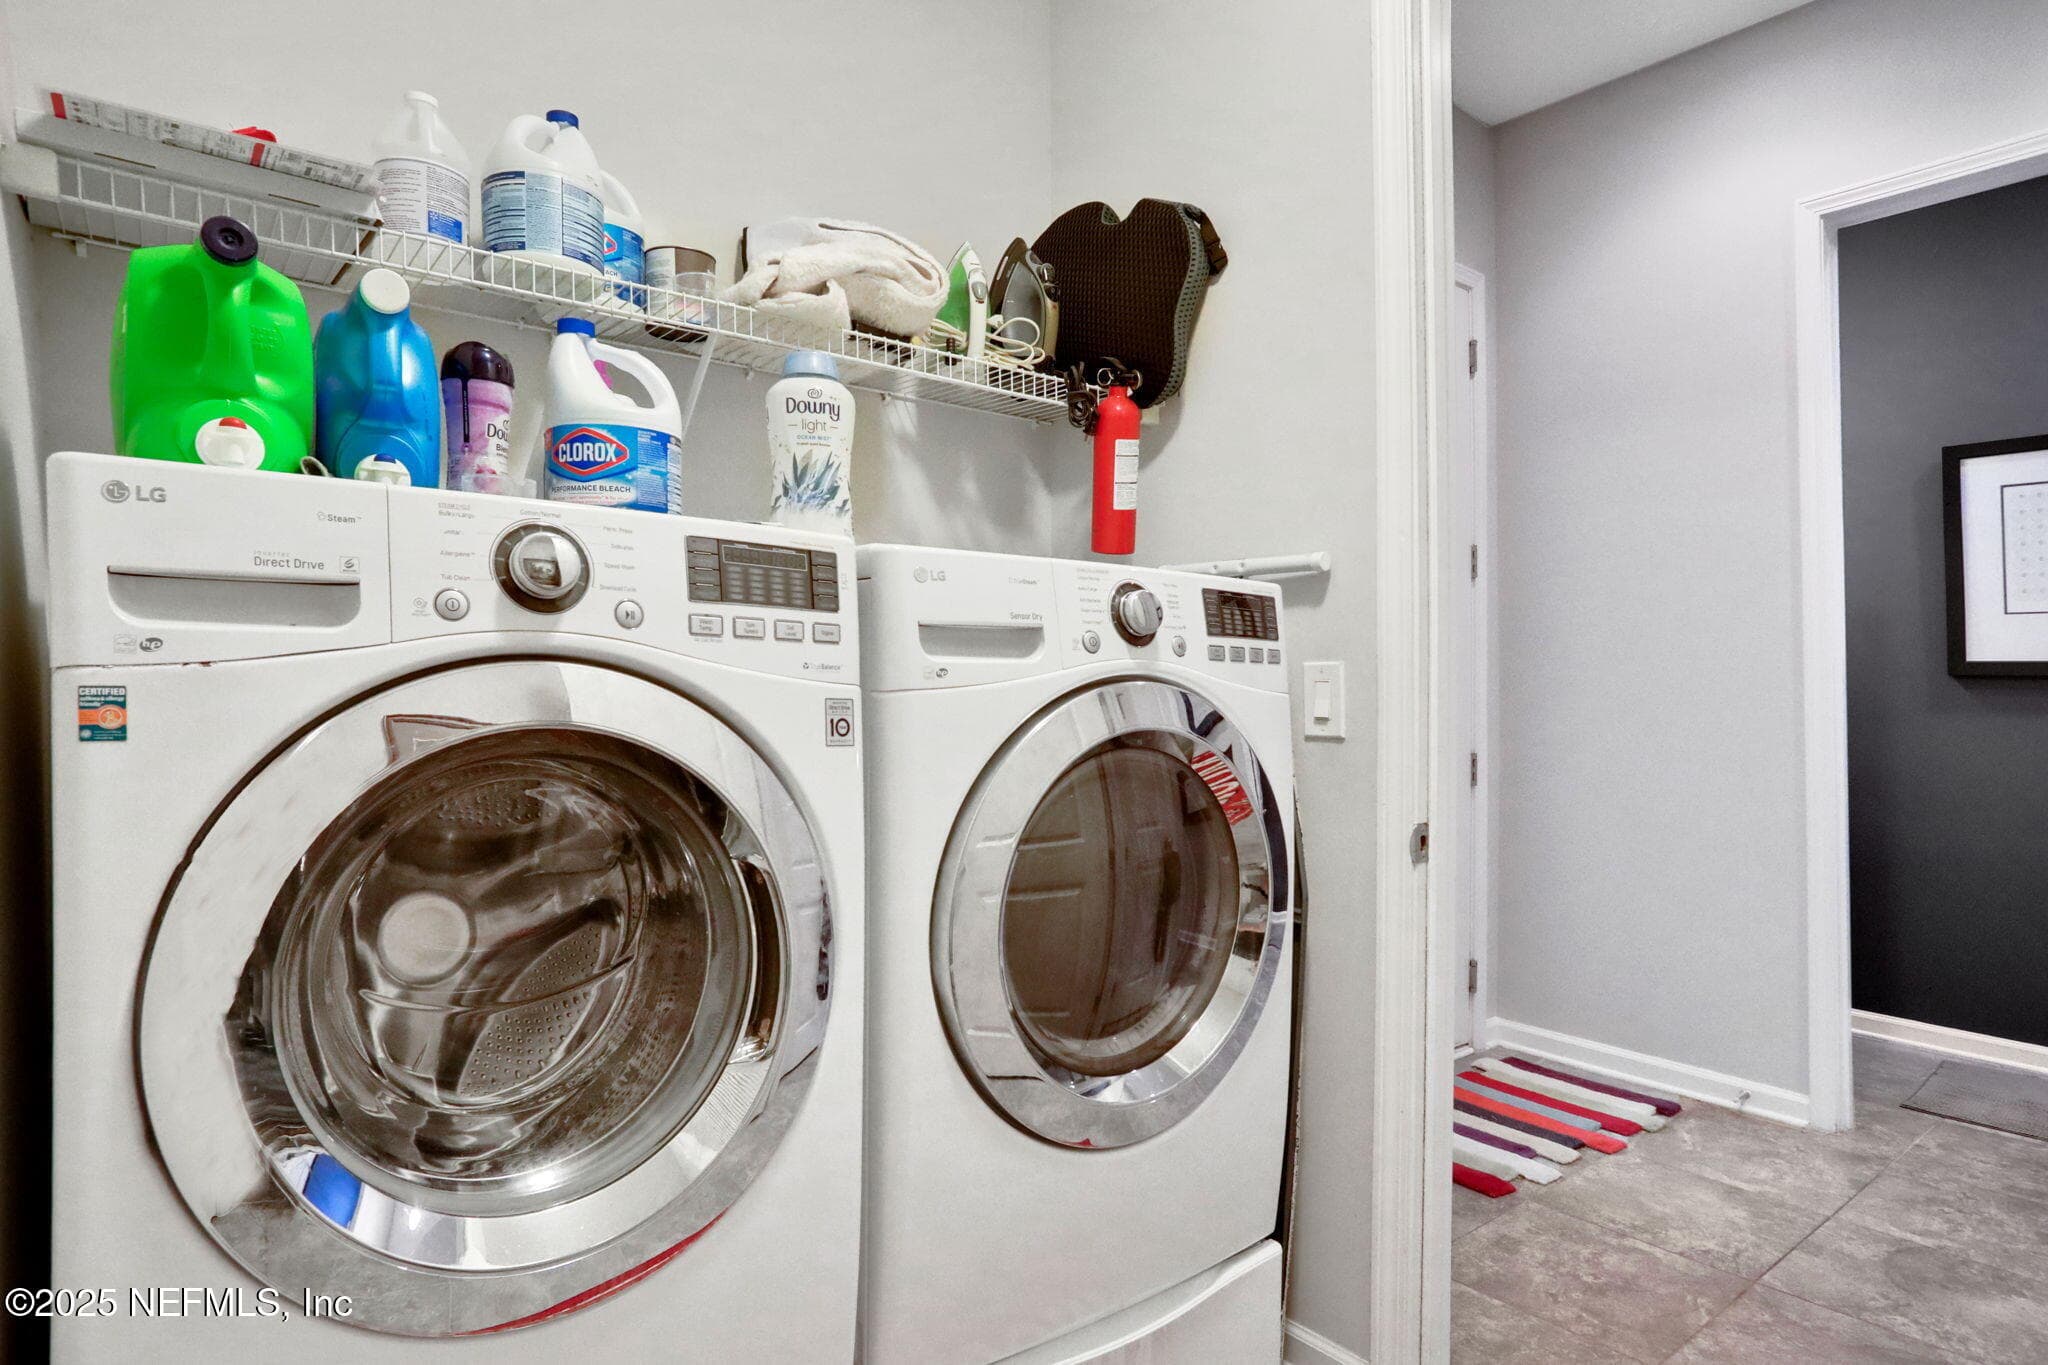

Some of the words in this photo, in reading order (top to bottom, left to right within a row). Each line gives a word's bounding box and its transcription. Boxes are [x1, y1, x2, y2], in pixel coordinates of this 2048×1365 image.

[785, 397, 840, 422] Downy
[801, 418, 827, 433] light
[558, 442, 617, 462] CLOROX
[135, 485, 167, 503] LG
[551, 484, 598, 494] PERFORMANCE
[599, 484, 631, 493] BLEACH
[254, 556, 291, 568] Direct
[293, 558, 325, 570] Drive
[930, 570, 946, 581] LG
[1010, 612, 1031, 620] Sensor
[830, 718, 850, 737] 10
